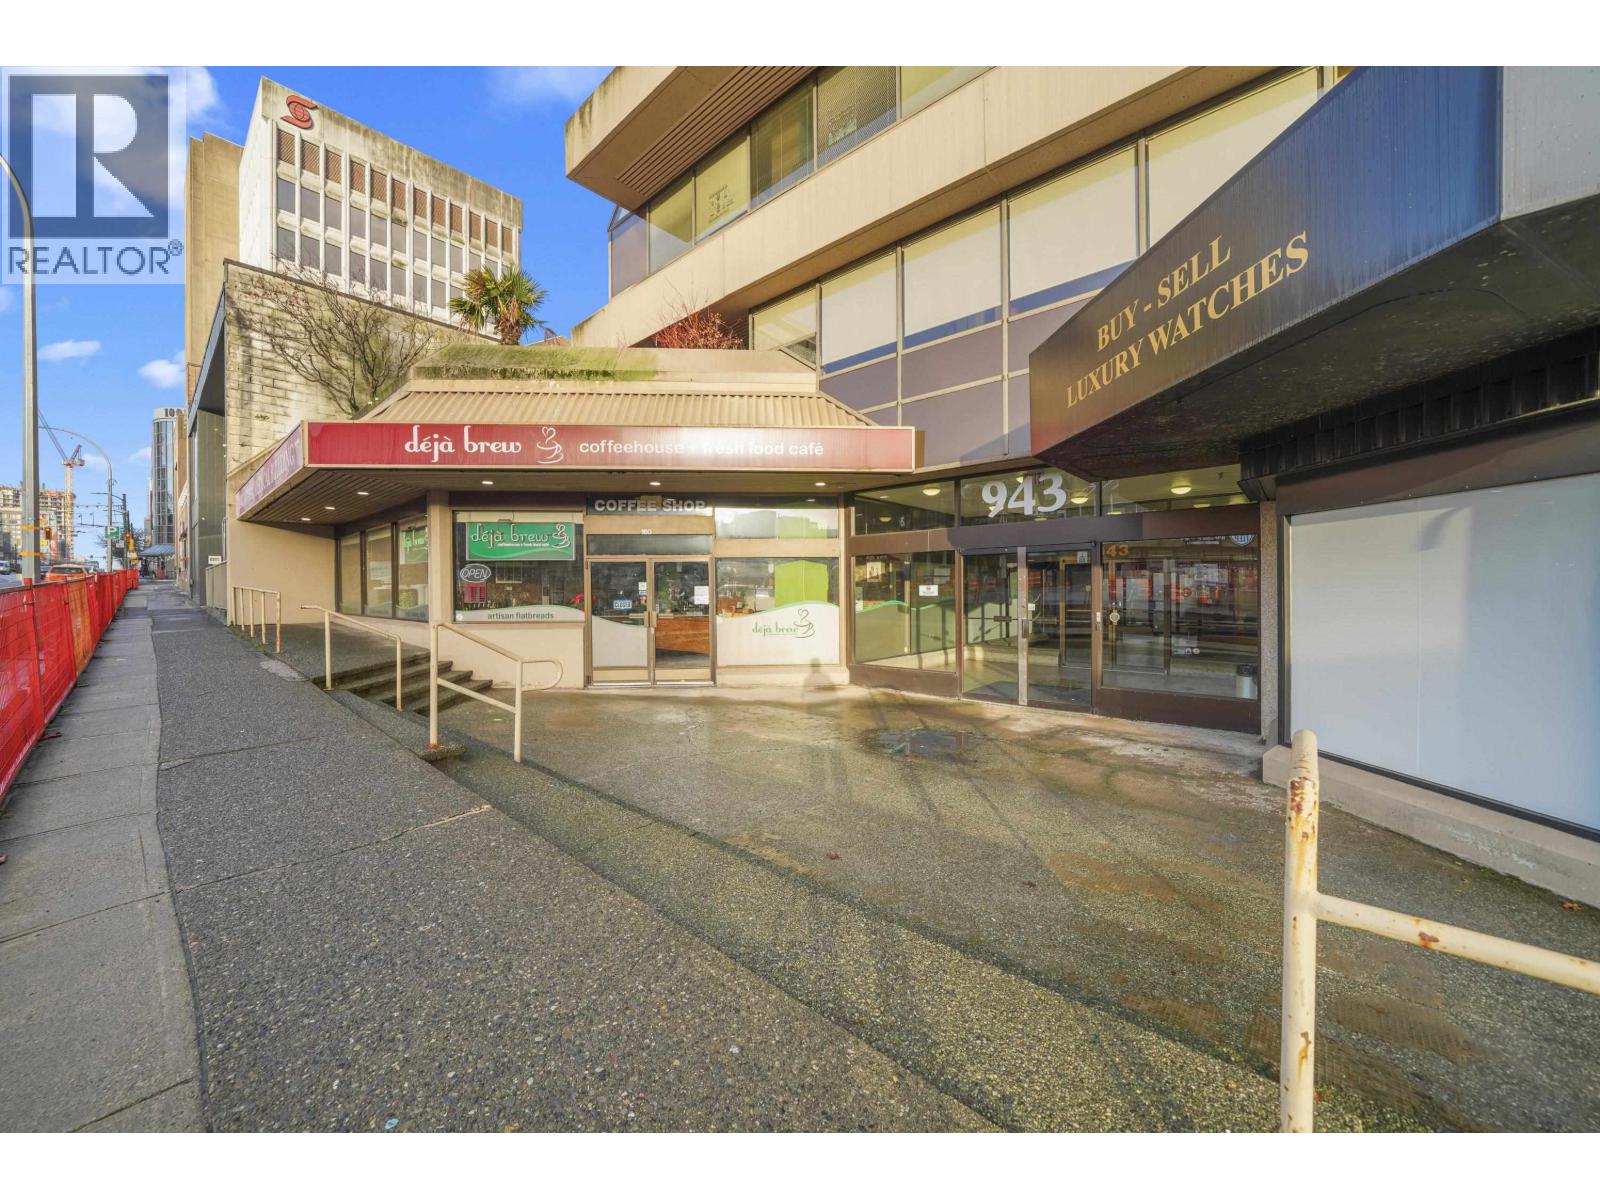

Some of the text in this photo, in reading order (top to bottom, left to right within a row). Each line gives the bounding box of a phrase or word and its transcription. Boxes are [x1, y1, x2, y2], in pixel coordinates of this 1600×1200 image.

[1097, 298, 1139, 352] BUY
[1157, 234, 1231, 309] SELL
[1067, 230, 1309, 408] LUXURY WATCHES
[404, 424, 522, 463] déjà brew
[579, 439, 683, 455] coffeehouse
[788, 442, 824, 457] café
[595, 499, 706, 512] COFFEE SHOP
[981, 472, 1067, 518] 943
[471, 523, 549, 548] déjà brew
[461, 568, 488, 578] OPEN
[487, 611, 554, 620] artisan flatbreads
